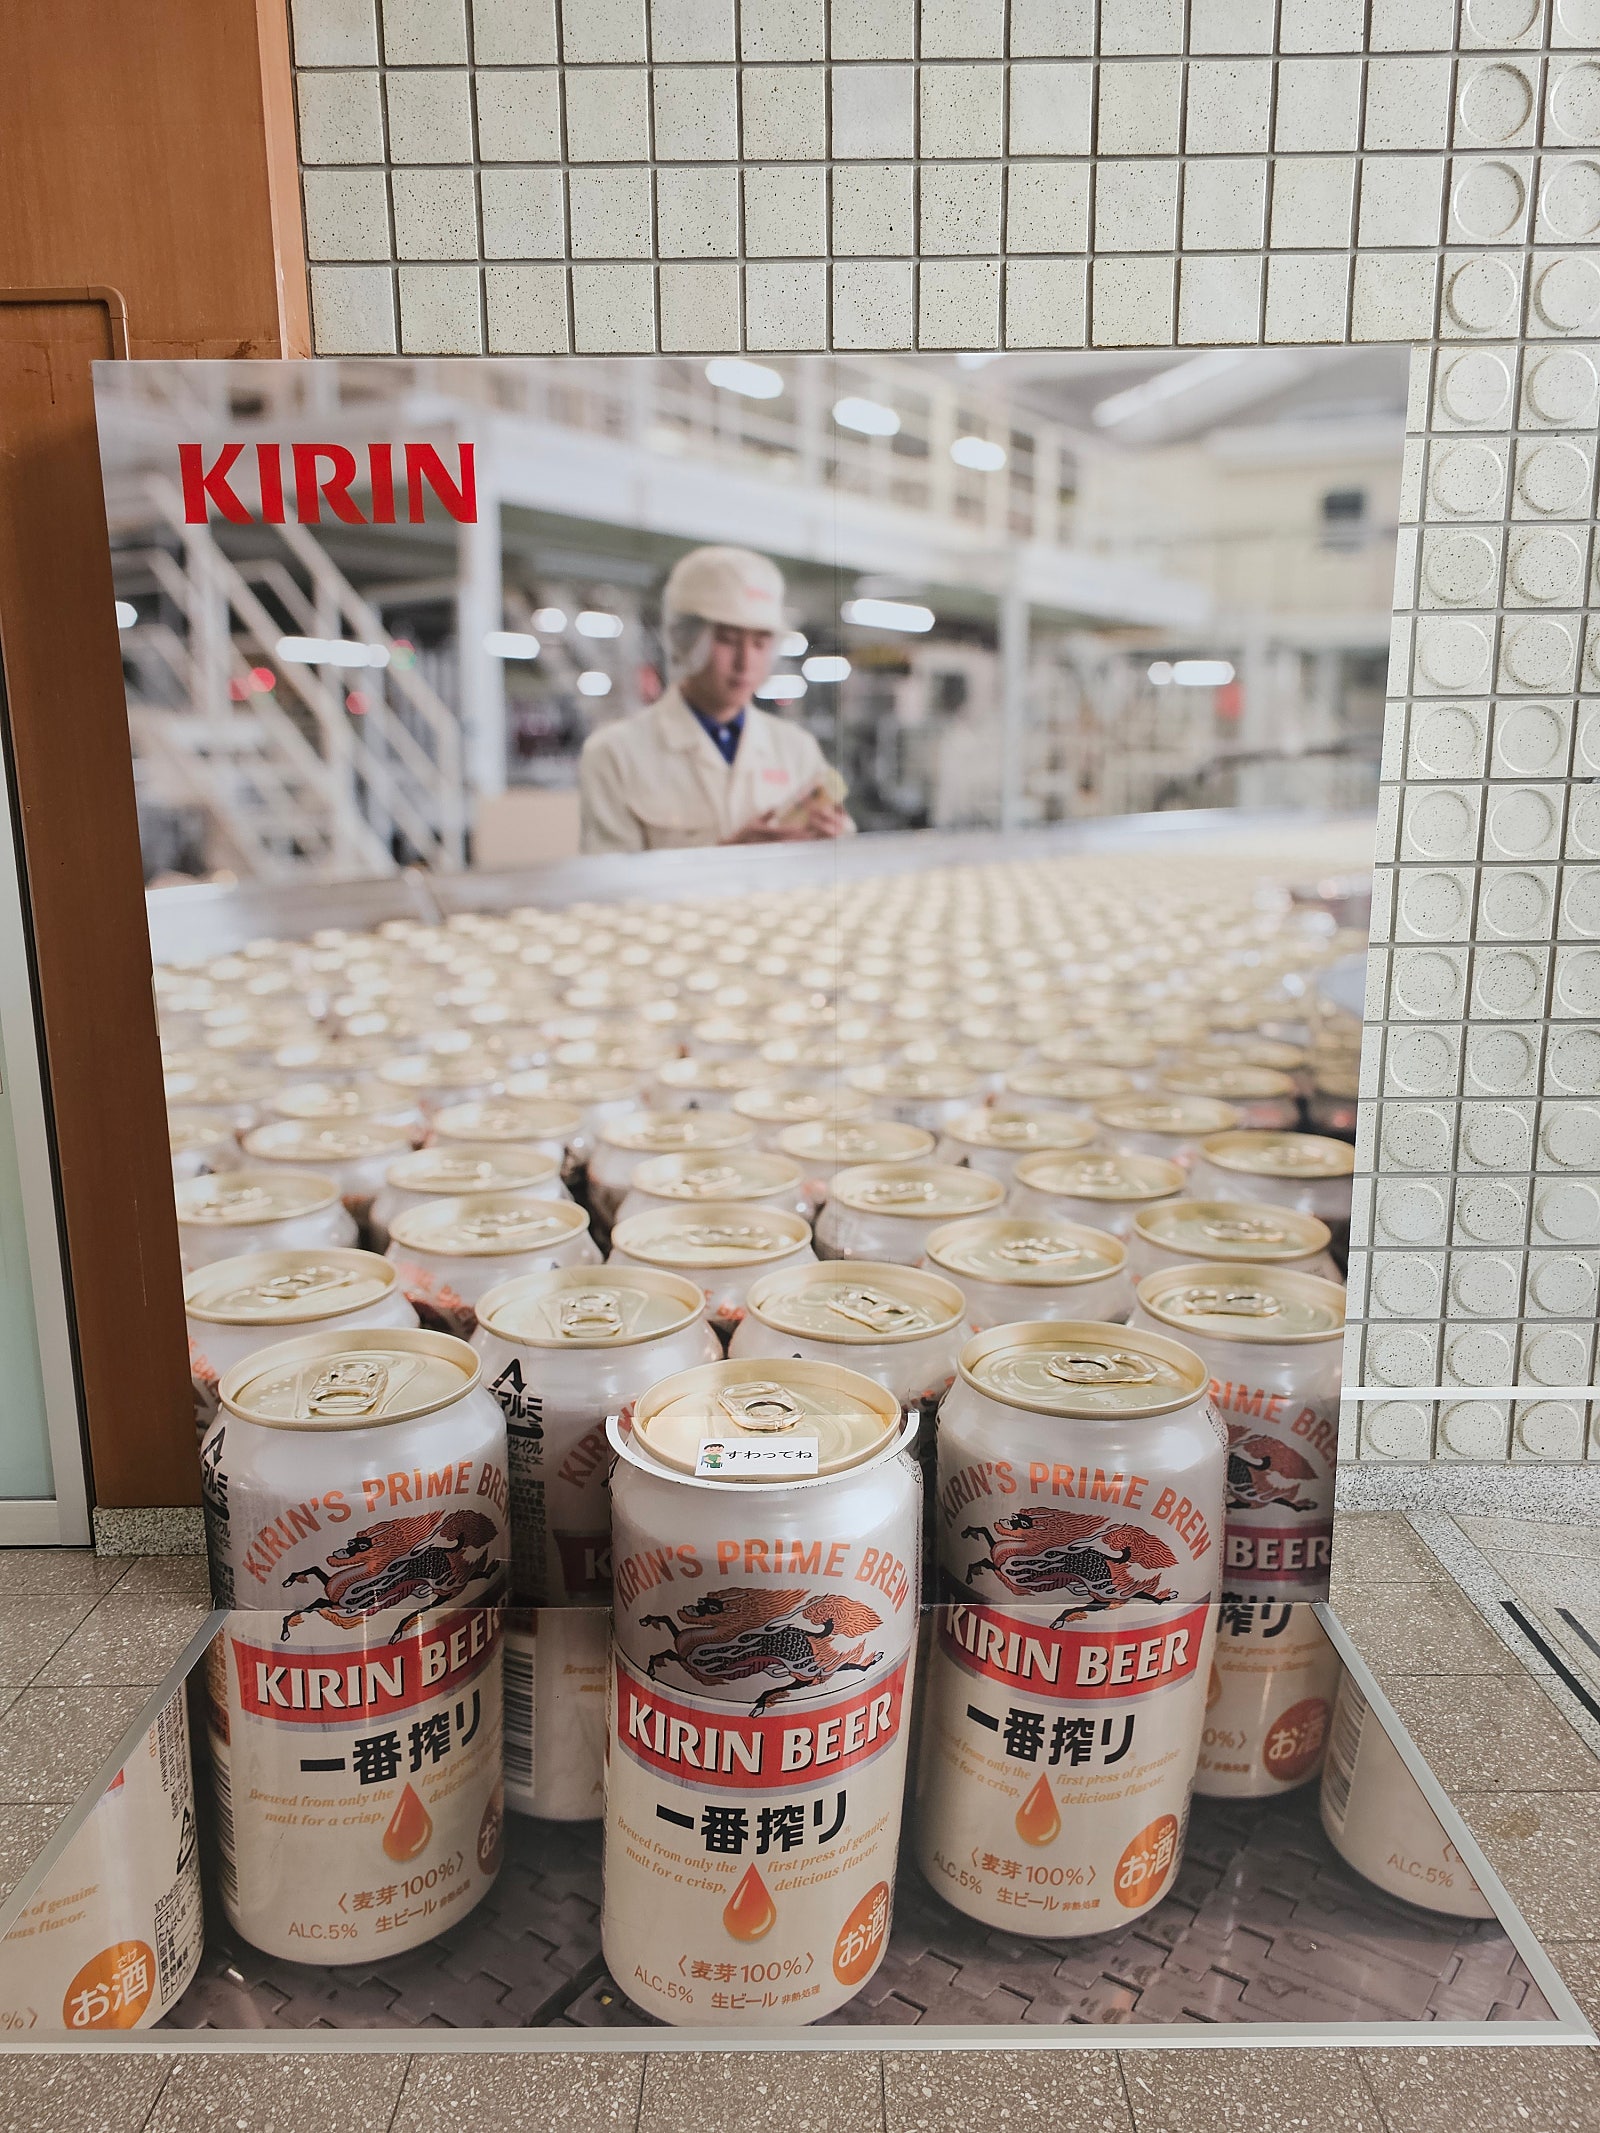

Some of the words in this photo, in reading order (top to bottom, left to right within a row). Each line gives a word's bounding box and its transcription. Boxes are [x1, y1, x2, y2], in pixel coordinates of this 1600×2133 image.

[178, 443, 478, 524] KIRIN
[1209, 1378, 1288, 1424] RIME
[1291, 1407, 1338, 1470] BRE
[725, 1450, 813, 1460] すわってね
[242, 1491, 352, 1584] KIRIN'S
[362, 1461, 473, 1513] PRIME
[939, 1462, 1017, 1528] KIRIN'S
[1029, 1462, 1149, 1510] PRIME
[1151, 1487, 1212, 1561] BREW
[616, 1545, 703, 1612] KIRIN'S
[717, 1539, 852, 1577] PRIME
[855, 1547, 909, 1613] BREW
[1226, 1535, 1331, 1571] BEER
[946, 1594, 1062, 1684] KIRIN
[1076, 1628, 1190, 1686] BEER
[1217, 1592, 1293, 1638] 搾り
[256, 1656, 404, 1709] KIRIN
[300, 1689, 480, 1785] 一番搾り
[629, 1693, 763, 1775] KIRIN
[781, 1691, 892, 1774] BEER
[967, 1704, 1135, 1766] 一番搾り
[249, 1788, 298, 1806] Brewed
[301, 1795, 334, 1808] from
[338, 1793, 369, 1807] only
[373, 1788, 394, 1801] the
[1013, 1767, 1031, 1780] the
[1056, 1774, 1084, 1785] first
[1086, 1773, 1120, 1787] press
[1122, 1766, 1137, 1779] of
[1061, 1791, 1122, 1804] delicious
[1125, 1775, 1165, 1797] flavor.
[265, 1813, 297, 1825] malt
[301, 1814, 324, 1826] for
[328, 1818, 337, 1826] a
[618, 1815, 652, 1849] Brewed
[653, 1842, 681, 1862] from
[685, 1858, 713, 1873] only
[716, 1860, 737, 1874] the
[767, 1859, 798, 1873] first
[800, 1850, 835, 1871] press
[838, 1838, 851, 1854] of
[852, 1811, 889, 1850] genuine
[655, 1789, 846, 1854] 一番搾り
[626, 1846, 650, 1868] malt
[652, 1861, 672, 1879] for
[674, 1873, 683, 1882] a
[687, 1877, 727, 1894] crisp,
[775, 1867, 840, 1901] delicious
[842, 1842, 878, 1873] flavor.
[1119, 1829, 1176, 1888] お酒
[1387, 1853, 1454, 1888] ALC.5%
[31, 1900, 46, 1916] of
[38, 1909, 87, 1934] flavor.
[288, 1922, 358, 1940] ALC.5%
[375, 1898, 438, 1933] 生ビール
[838, 1895, 887, 1968] お酒
[71, 1954, 149, 2027] お酒
[634, 1965, 694, 2004] ALC.5%
[711, 1992, 779, 2009] 生ビール
